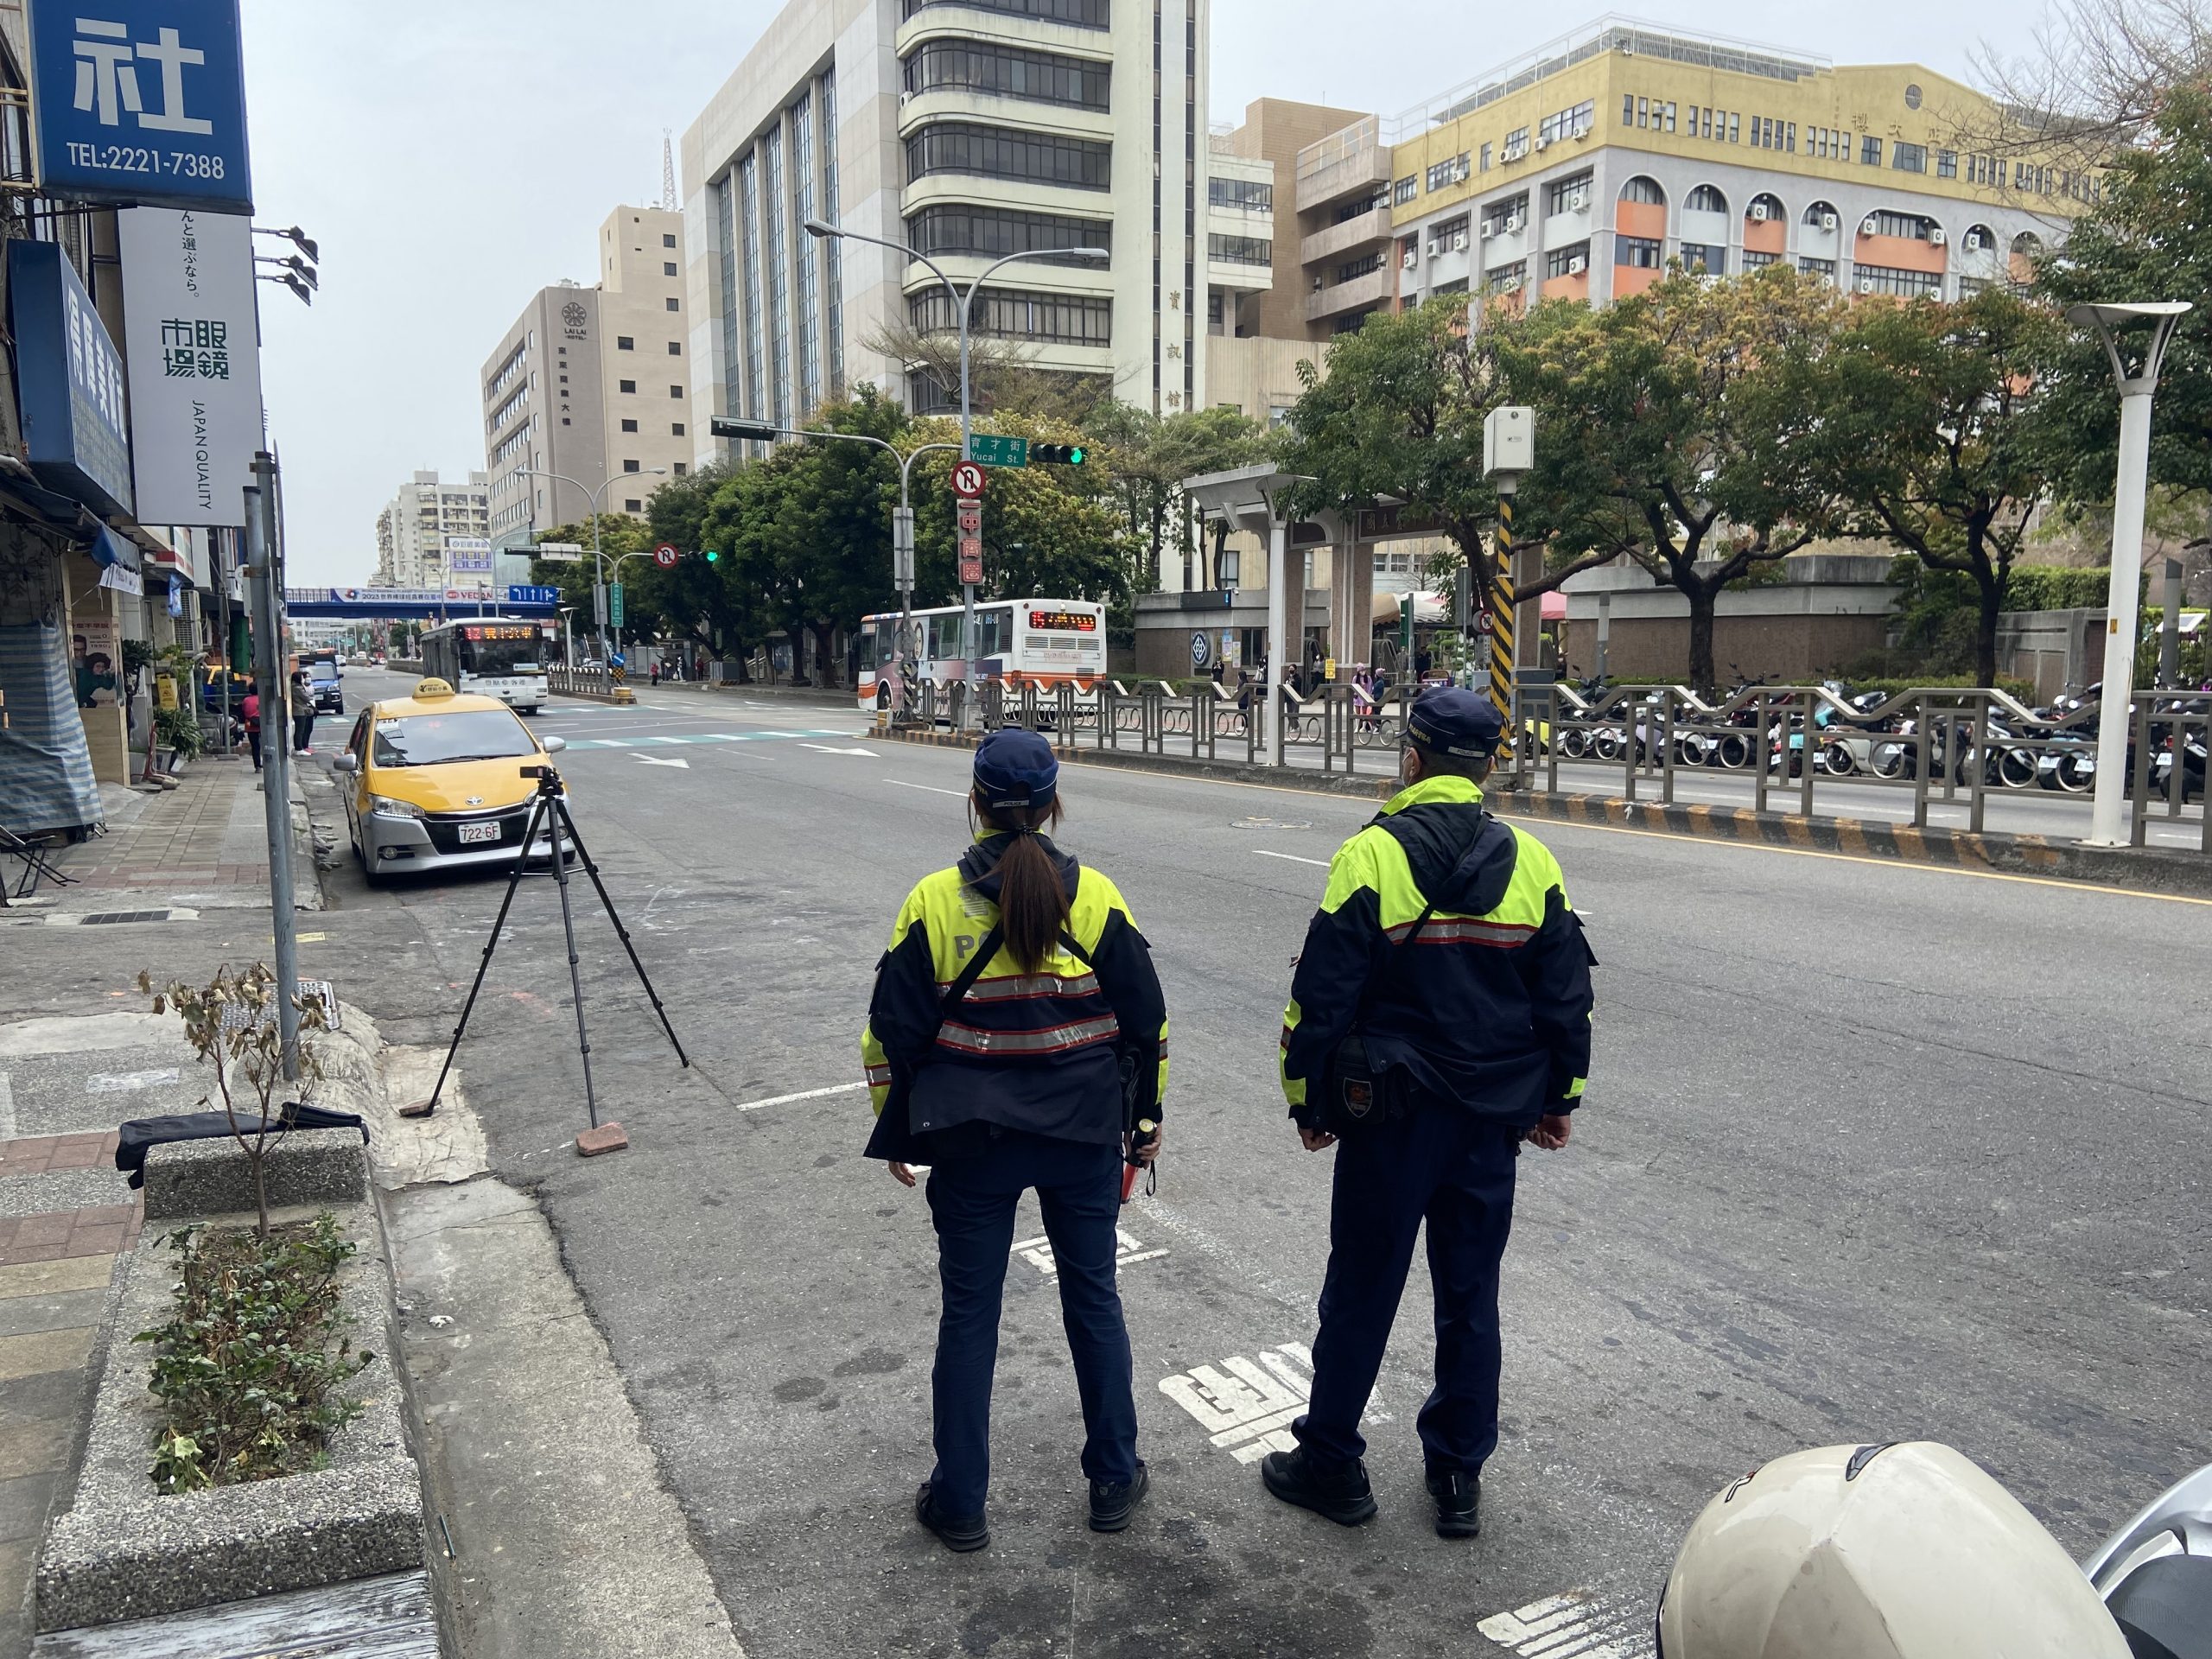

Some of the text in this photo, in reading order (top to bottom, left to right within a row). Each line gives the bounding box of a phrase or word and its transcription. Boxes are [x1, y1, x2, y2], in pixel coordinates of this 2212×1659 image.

[73, 17, 213, 135] 社
[67, 142, 225, 180] TEL:2221-7388
[193, 400, 212, 511] JAPAN QUALITY
[971, 437, 1020, 452] 育才街
[971, 452, 1019, 464] Yucai St.
[959, 502, 982, 582] 一中商圈
[461, 825, 499, 841] 722-6F
